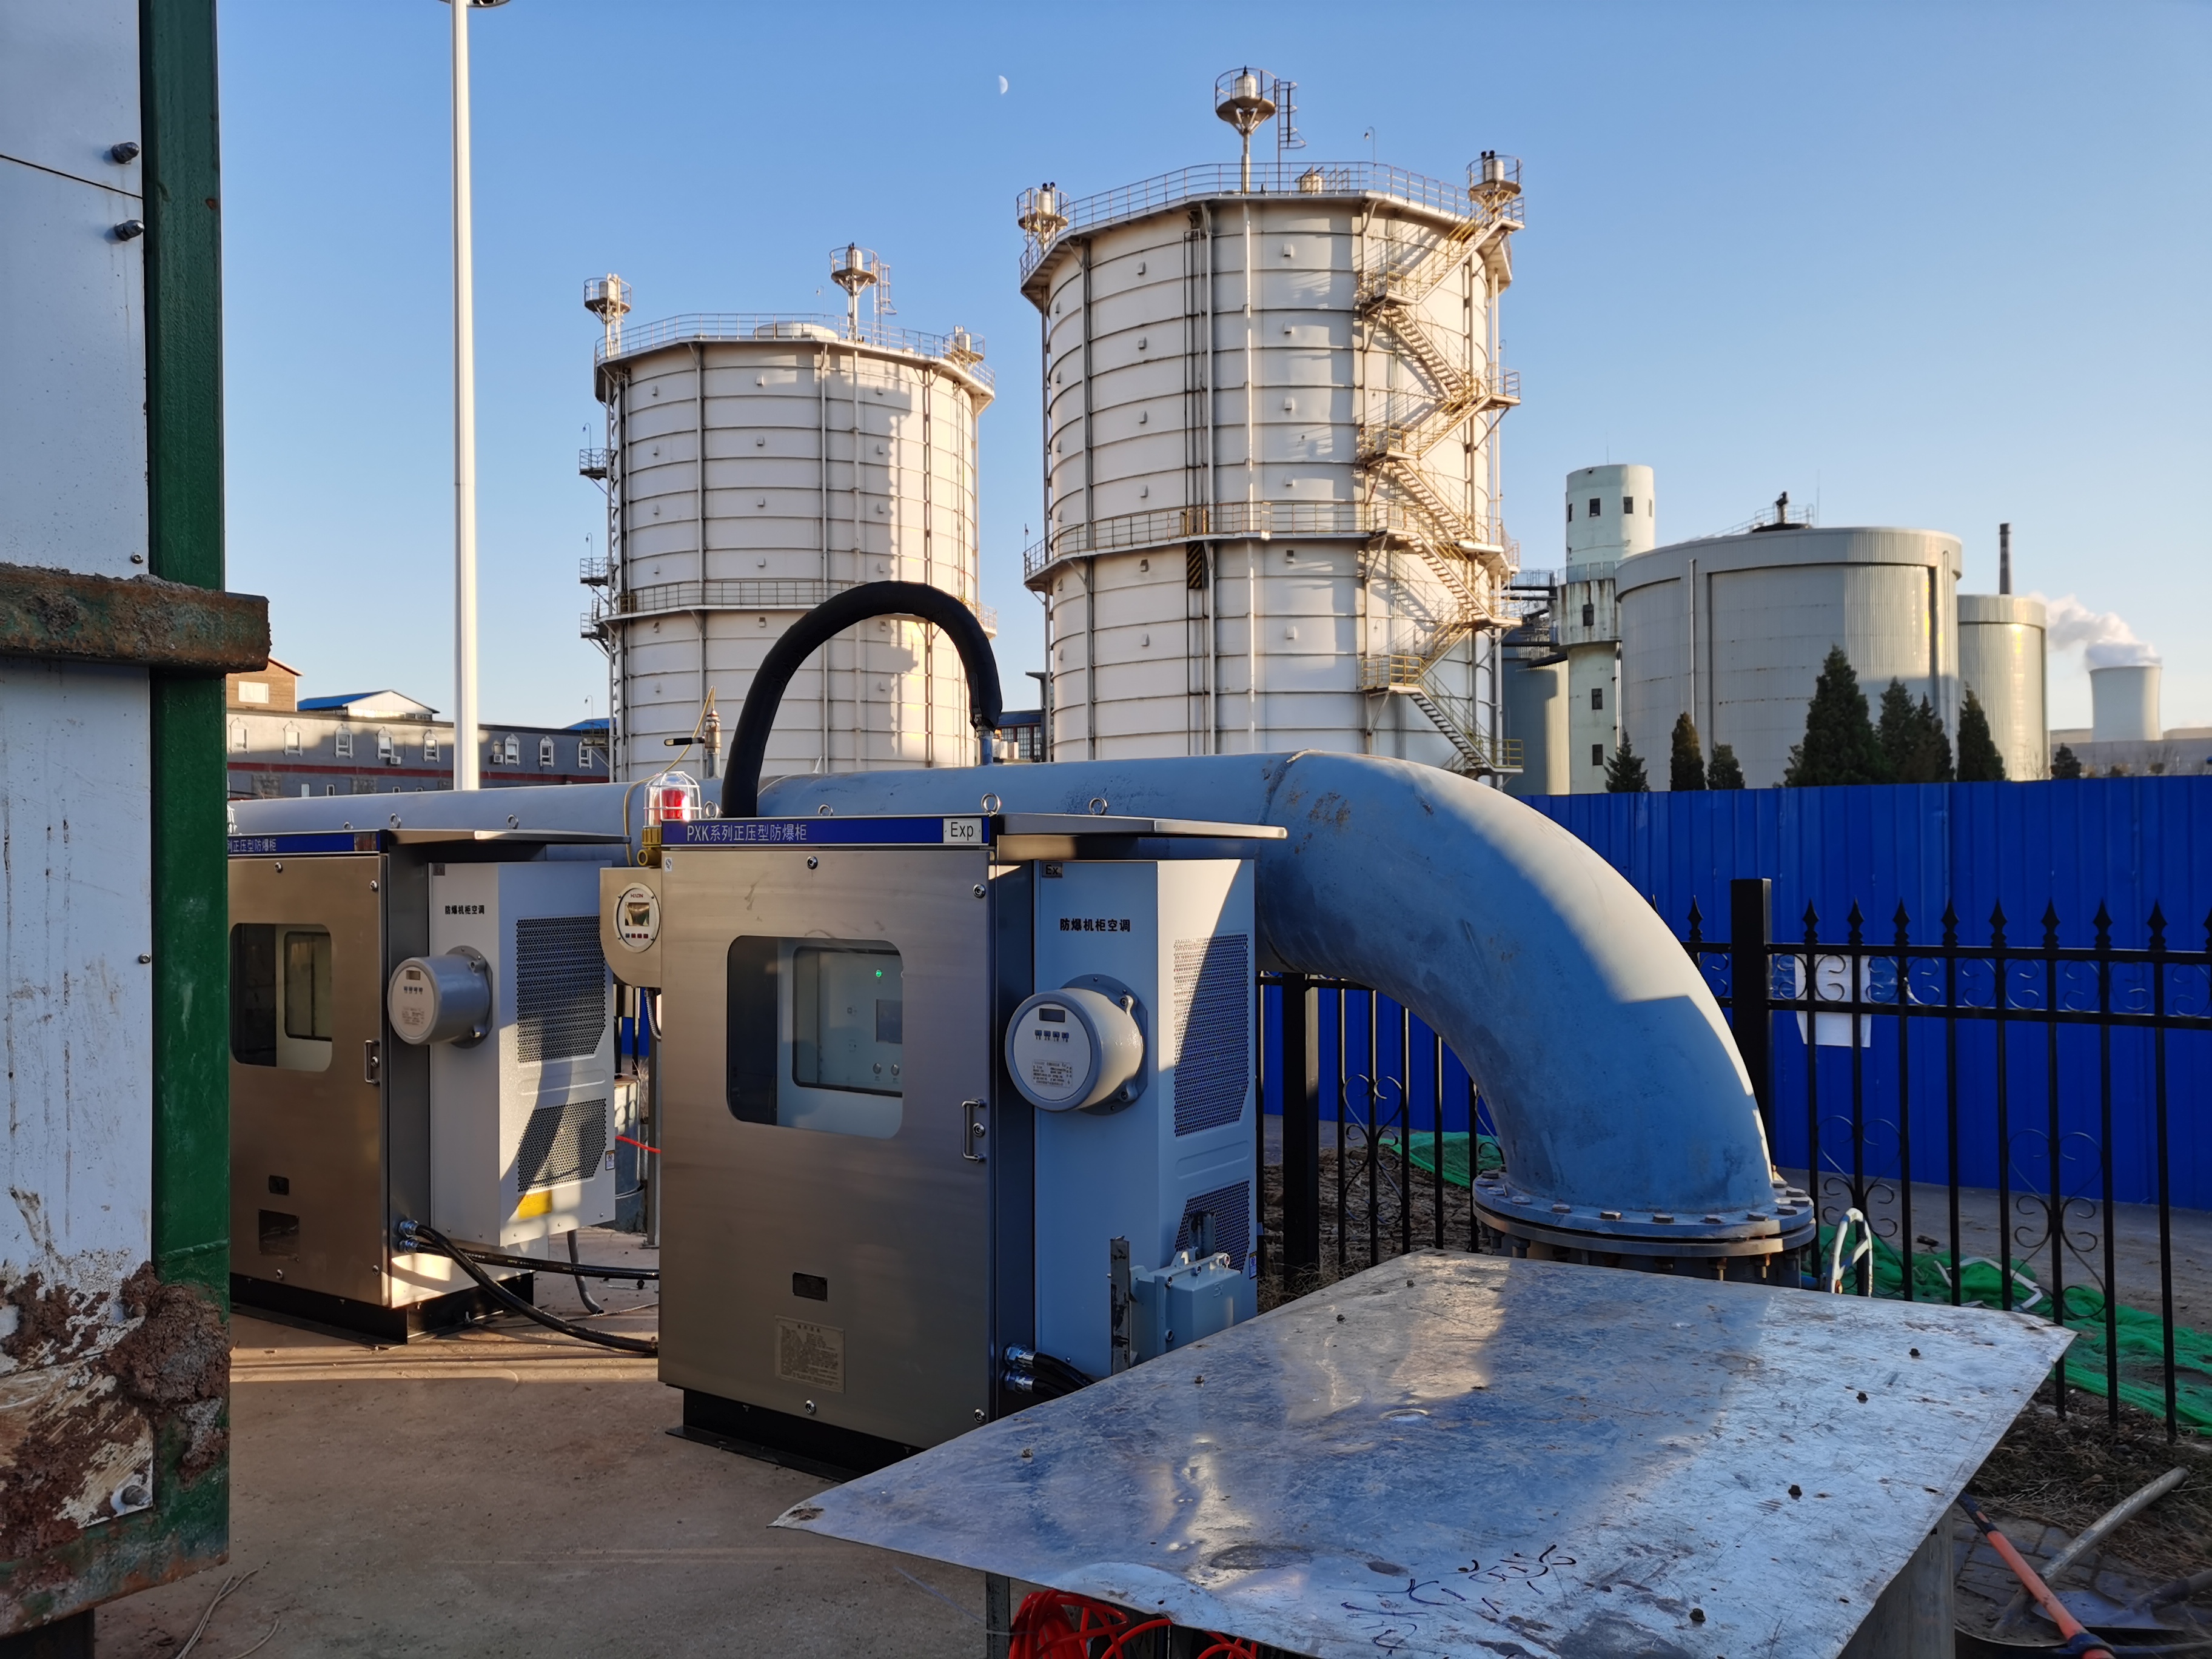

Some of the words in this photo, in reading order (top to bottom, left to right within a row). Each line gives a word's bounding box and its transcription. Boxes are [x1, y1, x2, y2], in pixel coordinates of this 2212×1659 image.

[687, 823, 807, 842] PXK系列正压型防爆柜
[951, 822, 974, 841] Exp
[1045, 864, 1059, 875] Ex
[444, 905, 485, 914] 防爆机柜空调
[1060, 917, 1130, 932] 防爆机柜空调
